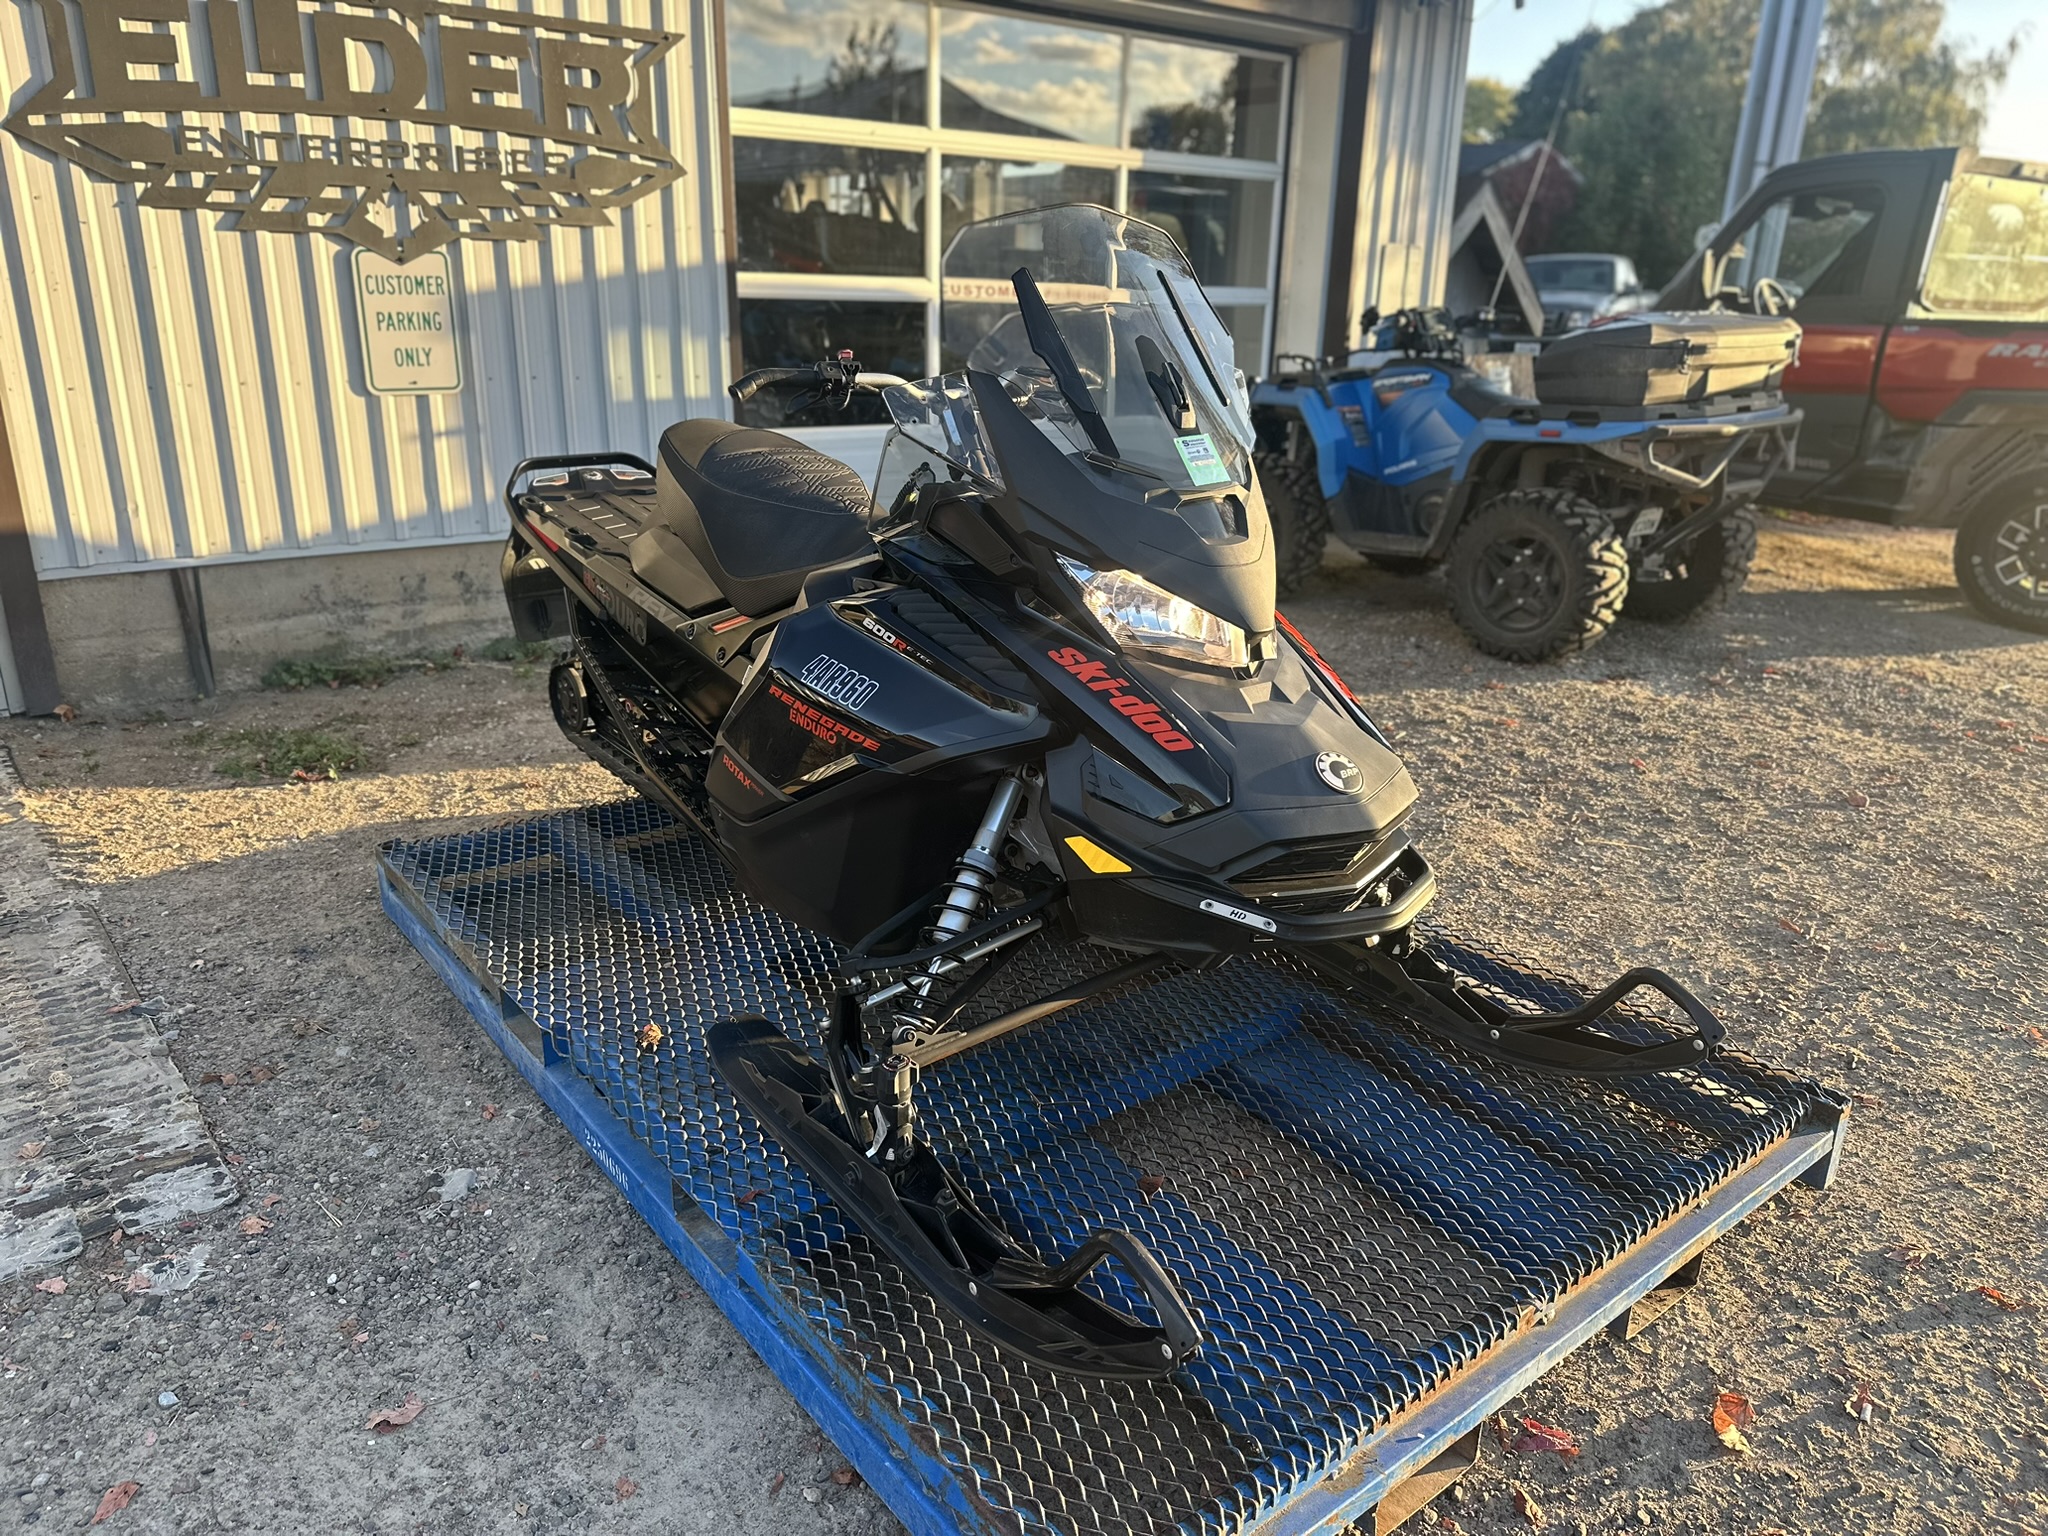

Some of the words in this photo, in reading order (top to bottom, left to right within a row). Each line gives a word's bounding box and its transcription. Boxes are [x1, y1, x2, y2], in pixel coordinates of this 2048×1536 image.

[76, 0, 648, 144] ELDER
[176, 125, 571, 177] ENTERPRISES
[364, 274, 446, 296] CUSTOMER
[376, 311, 442, 332] PARKING
[393, 346, 432, 368] ONLY
[800, 653, 880, 711] 4AR960
[768, 684, 881, 752] RENEGADE
[789, 707, 838, 745] ENDURO
[722, 753, 752, 790] ROTAX
[1340, 767, 1359, 779] BRP
[1229, 908, 1247, 921] HD
